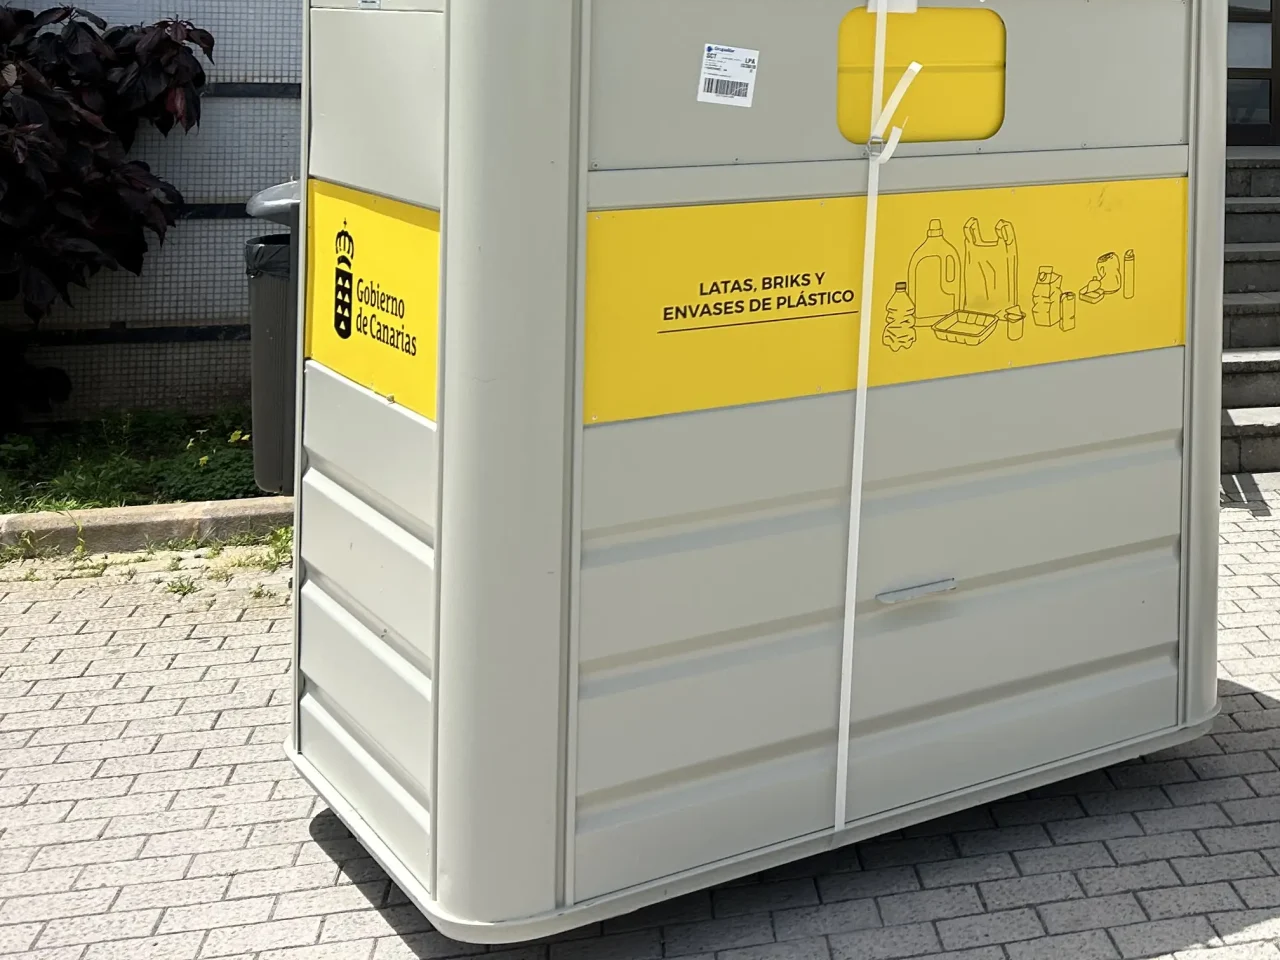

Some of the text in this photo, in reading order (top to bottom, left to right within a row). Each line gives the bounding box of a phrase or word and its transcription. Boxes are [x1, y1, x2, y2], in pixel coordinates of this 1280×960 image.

[357, 278, 405, 319] Gobierno
[700, 272, 826, 296] LATAS, BRIKS Y
[663, 290, 854, 321] ENVASES DE PLÁSTICO
[356, 307, 417, 357] de Canarias
